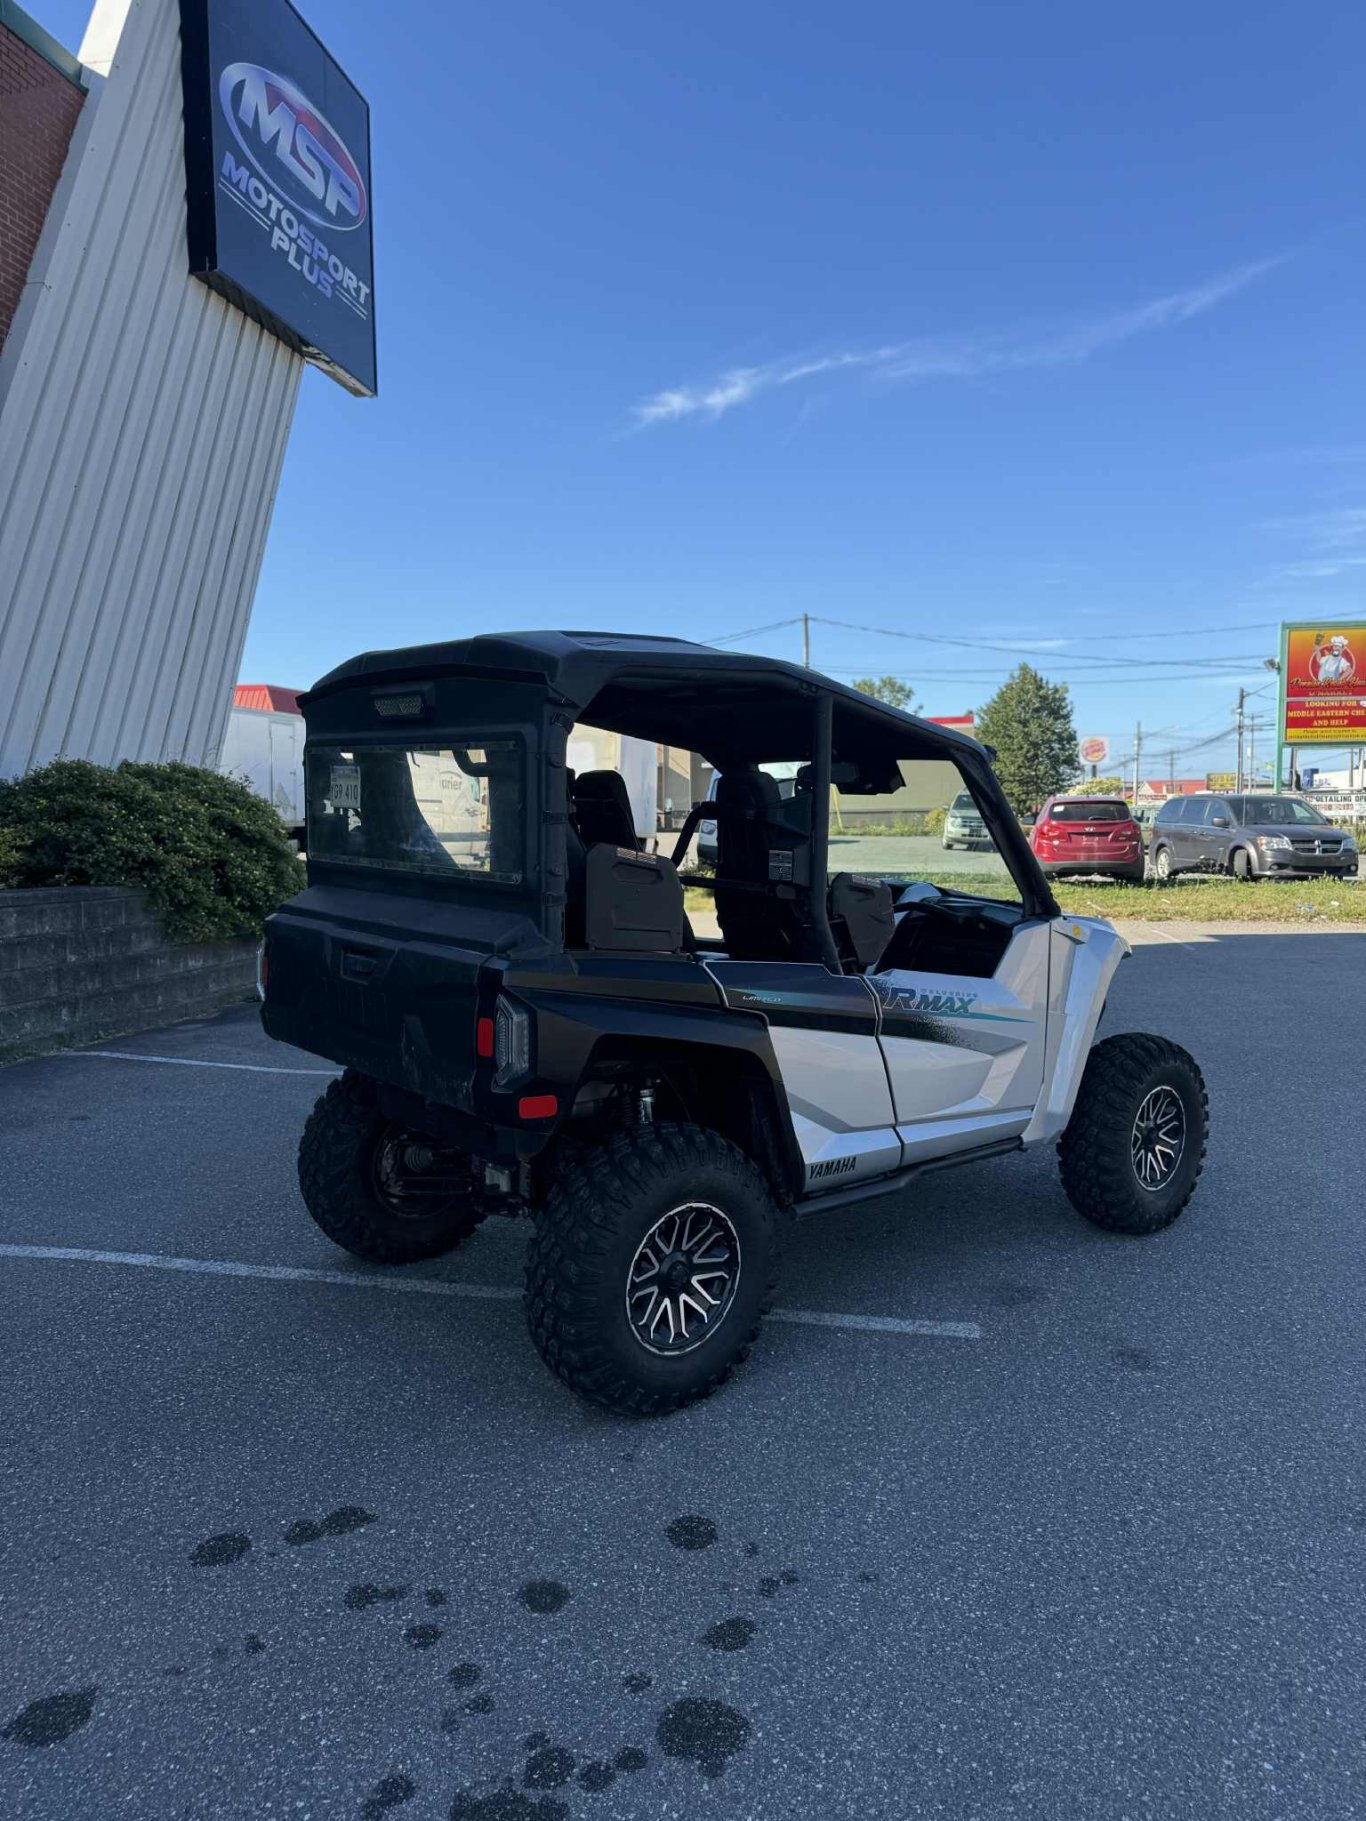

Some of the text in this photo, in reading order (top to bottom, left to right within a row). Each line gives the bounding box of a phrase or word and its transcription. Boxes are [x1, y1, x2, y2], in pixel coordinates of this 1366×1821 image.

[239, 76, 360, 217] MSP
[221, 151, 370, 305] MOTOSPORT
[271, 228, 333, 299] PLUS
[1287, 710, 1315, 718] MIDDLE
[440, 776, 462, 791] urier
[809, 1156, 857, 1179] YAMAHA
